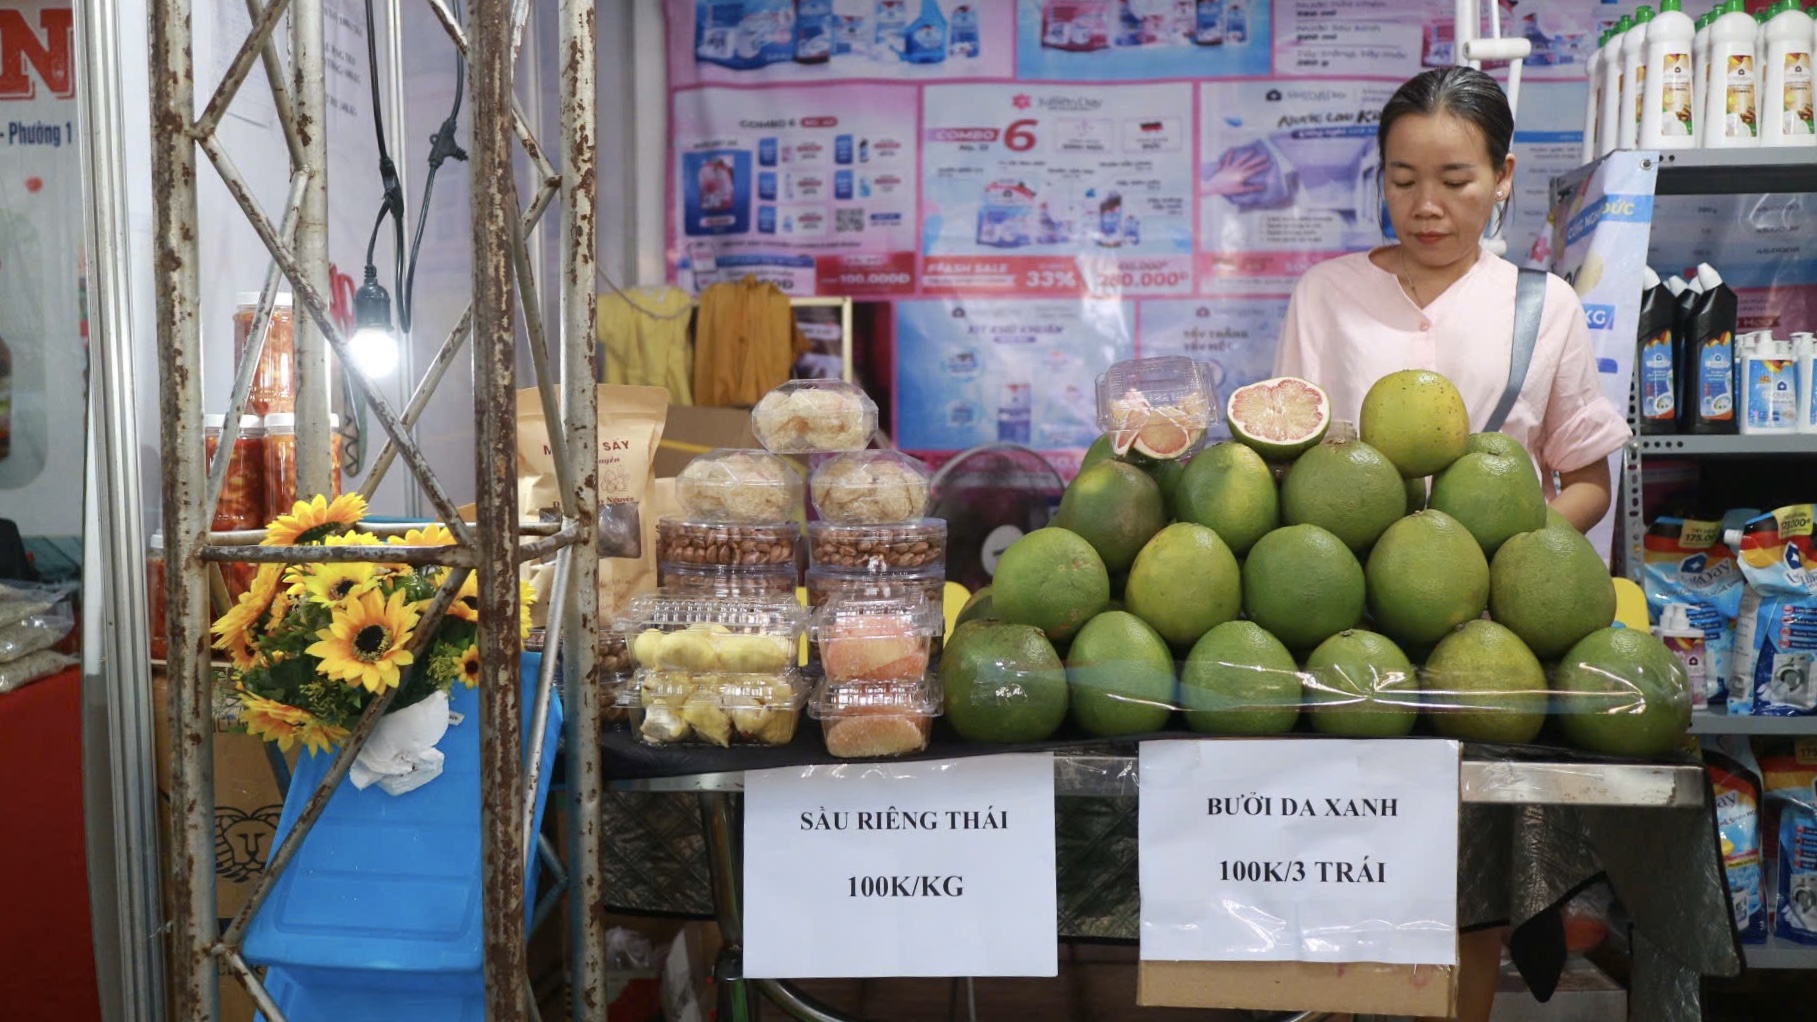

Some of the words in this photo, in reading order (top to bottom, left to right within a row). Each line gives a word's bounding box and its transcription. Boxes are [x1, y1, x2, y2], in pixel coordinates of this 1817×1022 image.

[935, 129, 996, 142] COMBO
[1003, 118, 1040, 152] 6
[1026, 270, 1076, 288] 33%
[800, 805, 849, 831] SẦU
[857, 805, 938, 831] RIÊNG
[945, 804, 1009, 830] THÁI
[1207, 792, 1272, 816] BƯỞI
[1281, 798, 1317, 817] DA
[1325, 798, 1398, 817] XANH
[1219, 859, 1306, 883] 100K/3
[1315, 855, 1387, 883] TRÁI
[847, 875, 964, 898] 100K/KG
